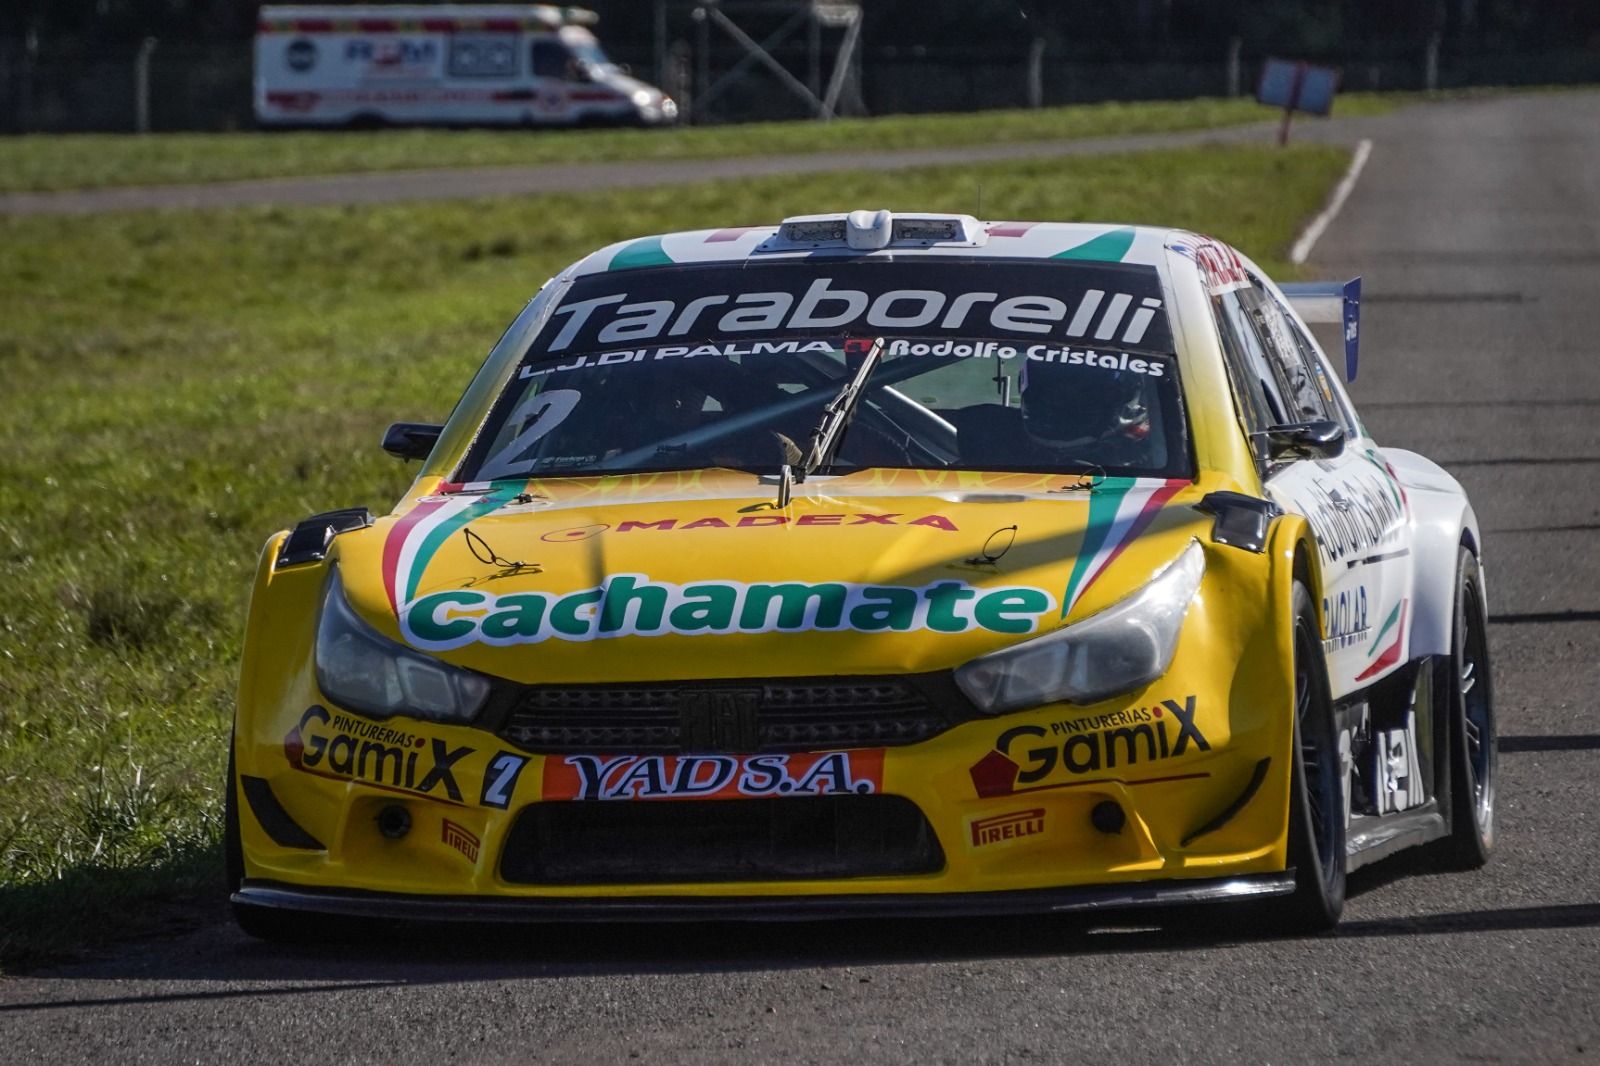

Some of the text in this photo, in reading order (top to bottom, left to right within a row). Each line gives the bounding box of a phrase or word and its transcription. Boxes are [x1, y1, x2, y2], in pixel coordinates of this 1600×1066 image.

[547, 277, 1162, 352] Taraborelli
[654, 340, 835, 361] PALMA
[889, 339, 1165, 377] Rodolfo Cristales
[473, 388, 582, 482] 2
[615, 513, 959, 532] MADEXA
[332, 715, 416, 748] PINTURERIAS
[996, 695, 1212, 783] GamiX
[1051, 706, 1152, 735] PINTURERIAS
[300, 704, 477, 803] GamiX
[484, 755, 523, 804] 2
[442, 818, 480, 865] PIRELLI
[971, 807, 1047, 847] PIRELLI
